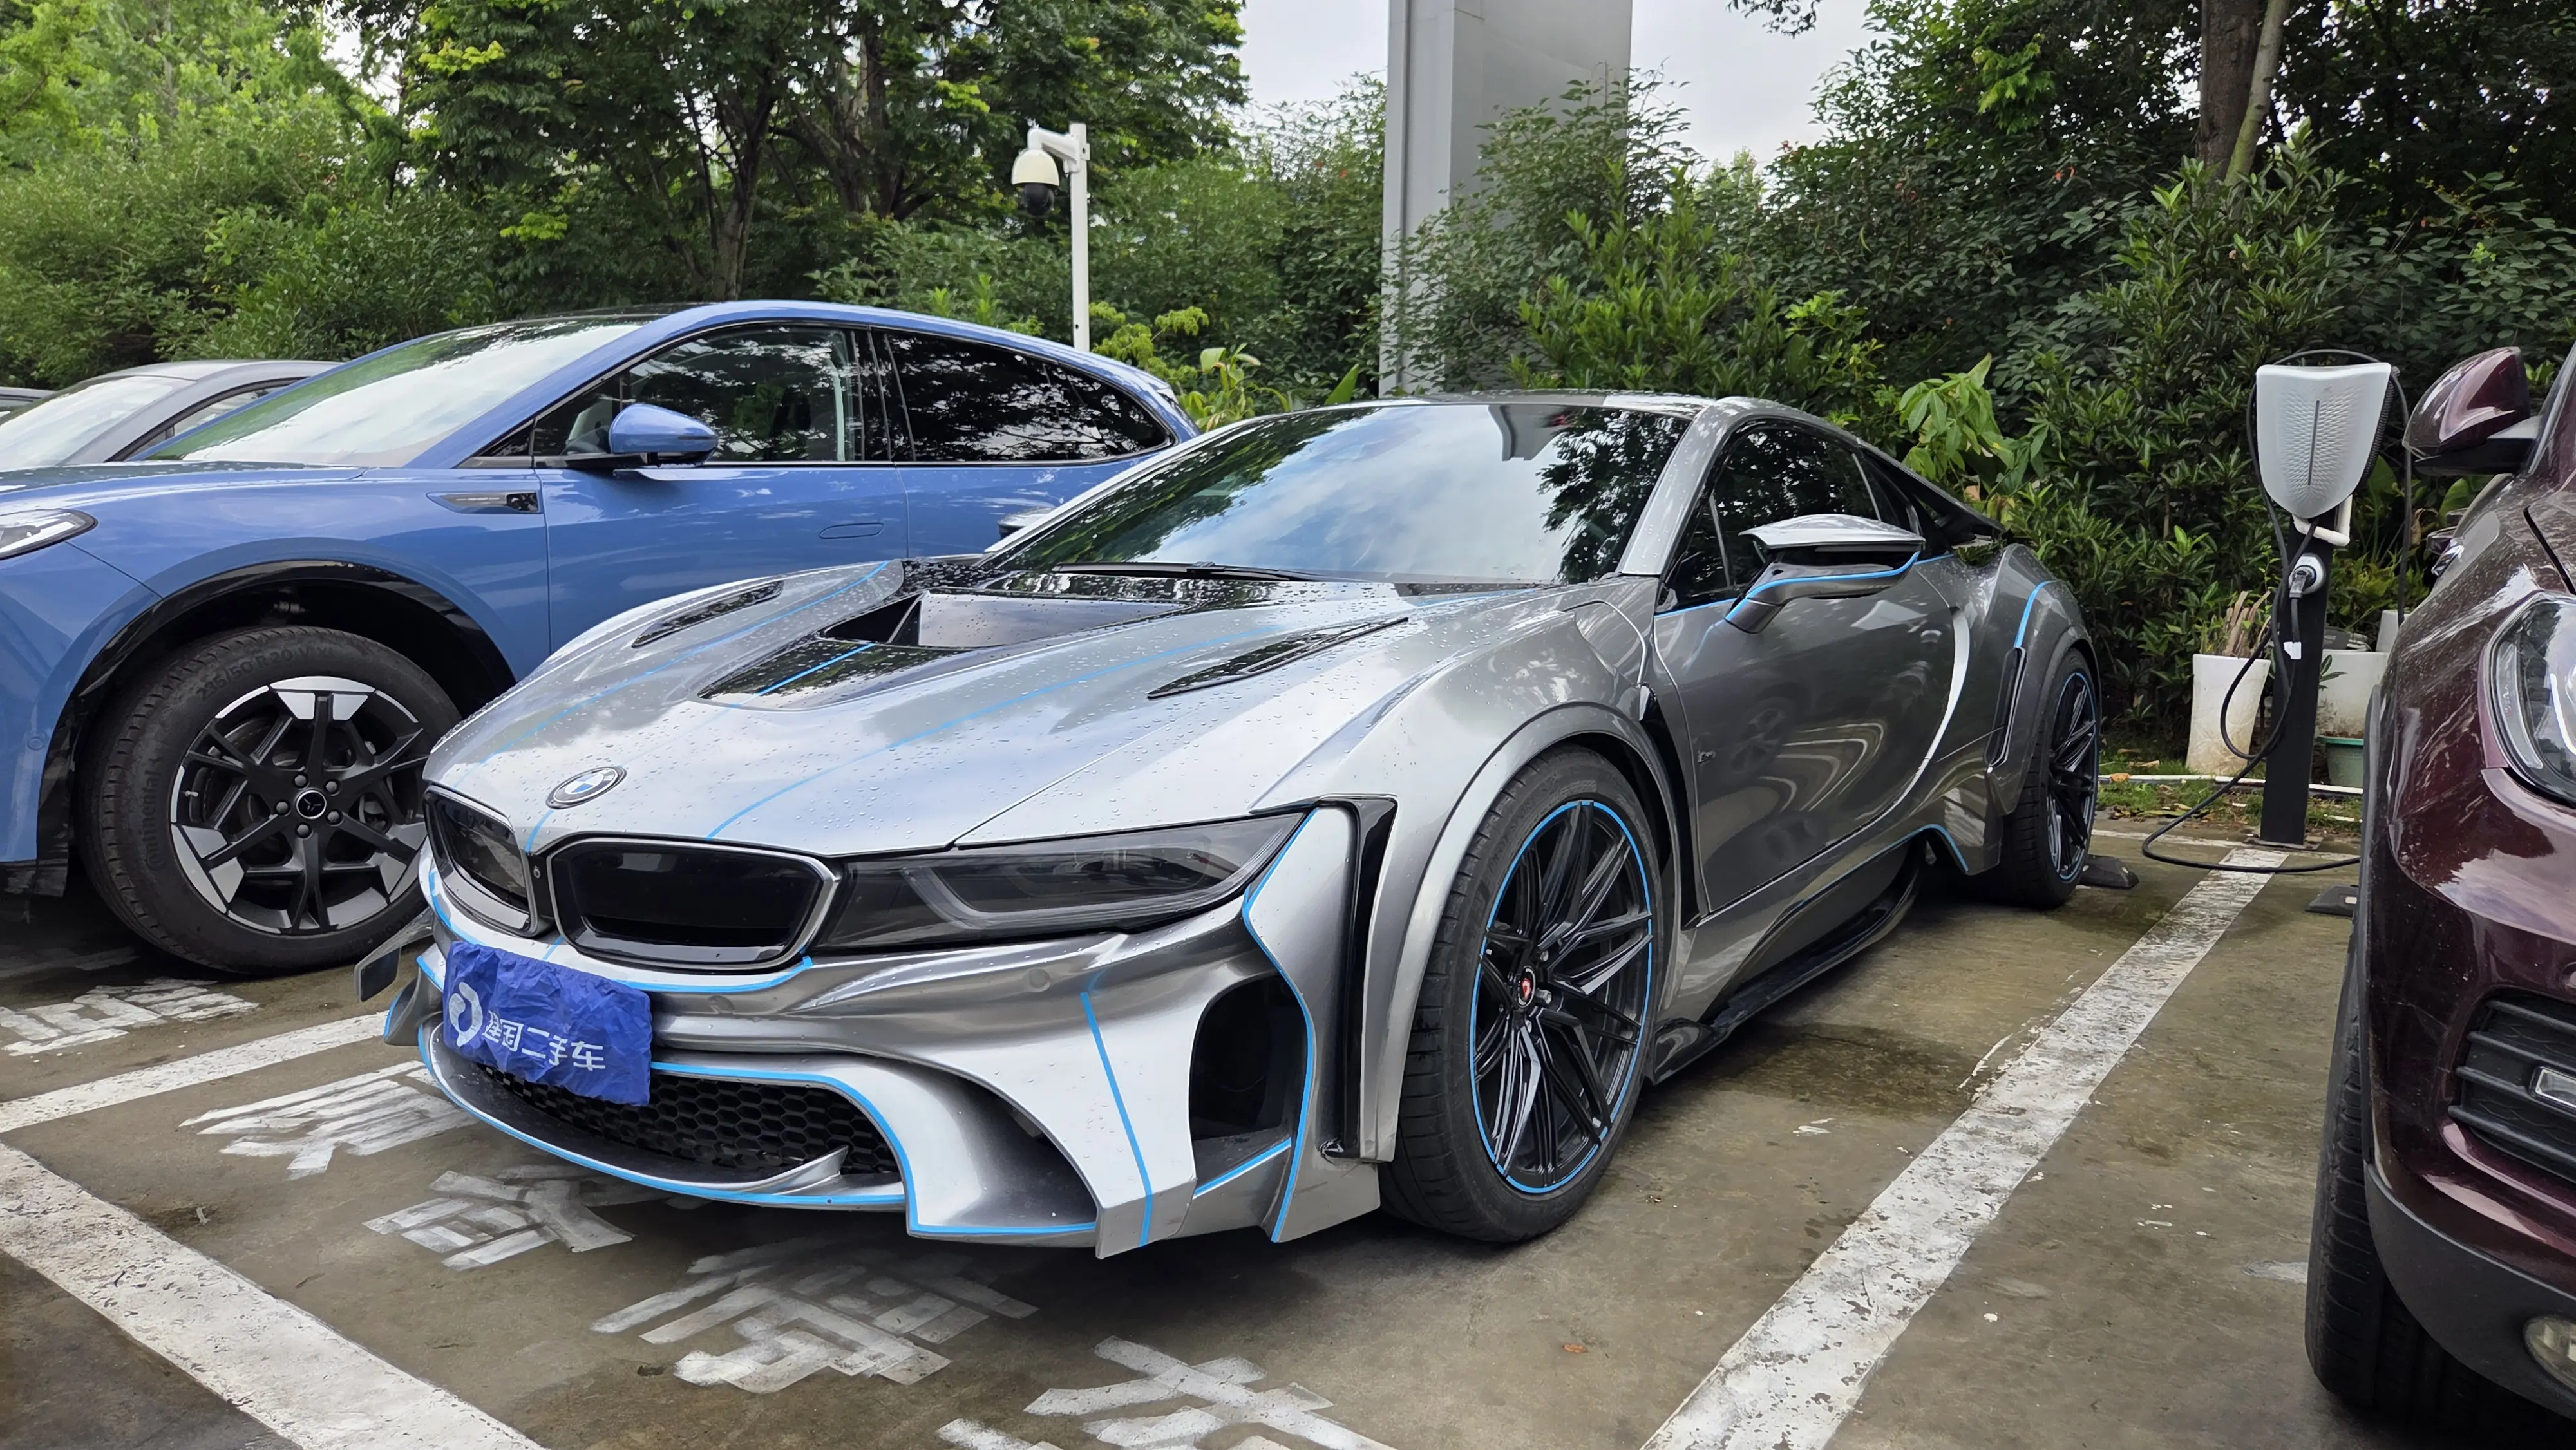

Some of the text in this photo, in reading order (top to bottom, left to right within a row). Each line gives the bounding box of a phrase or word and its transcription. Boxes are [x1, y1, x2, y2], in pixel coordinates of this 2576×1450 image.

[271, 648, 294, 663] 20
[142, 770, 164, 869] Continental
[482, 1010, 606, 1071] 建国二手车
